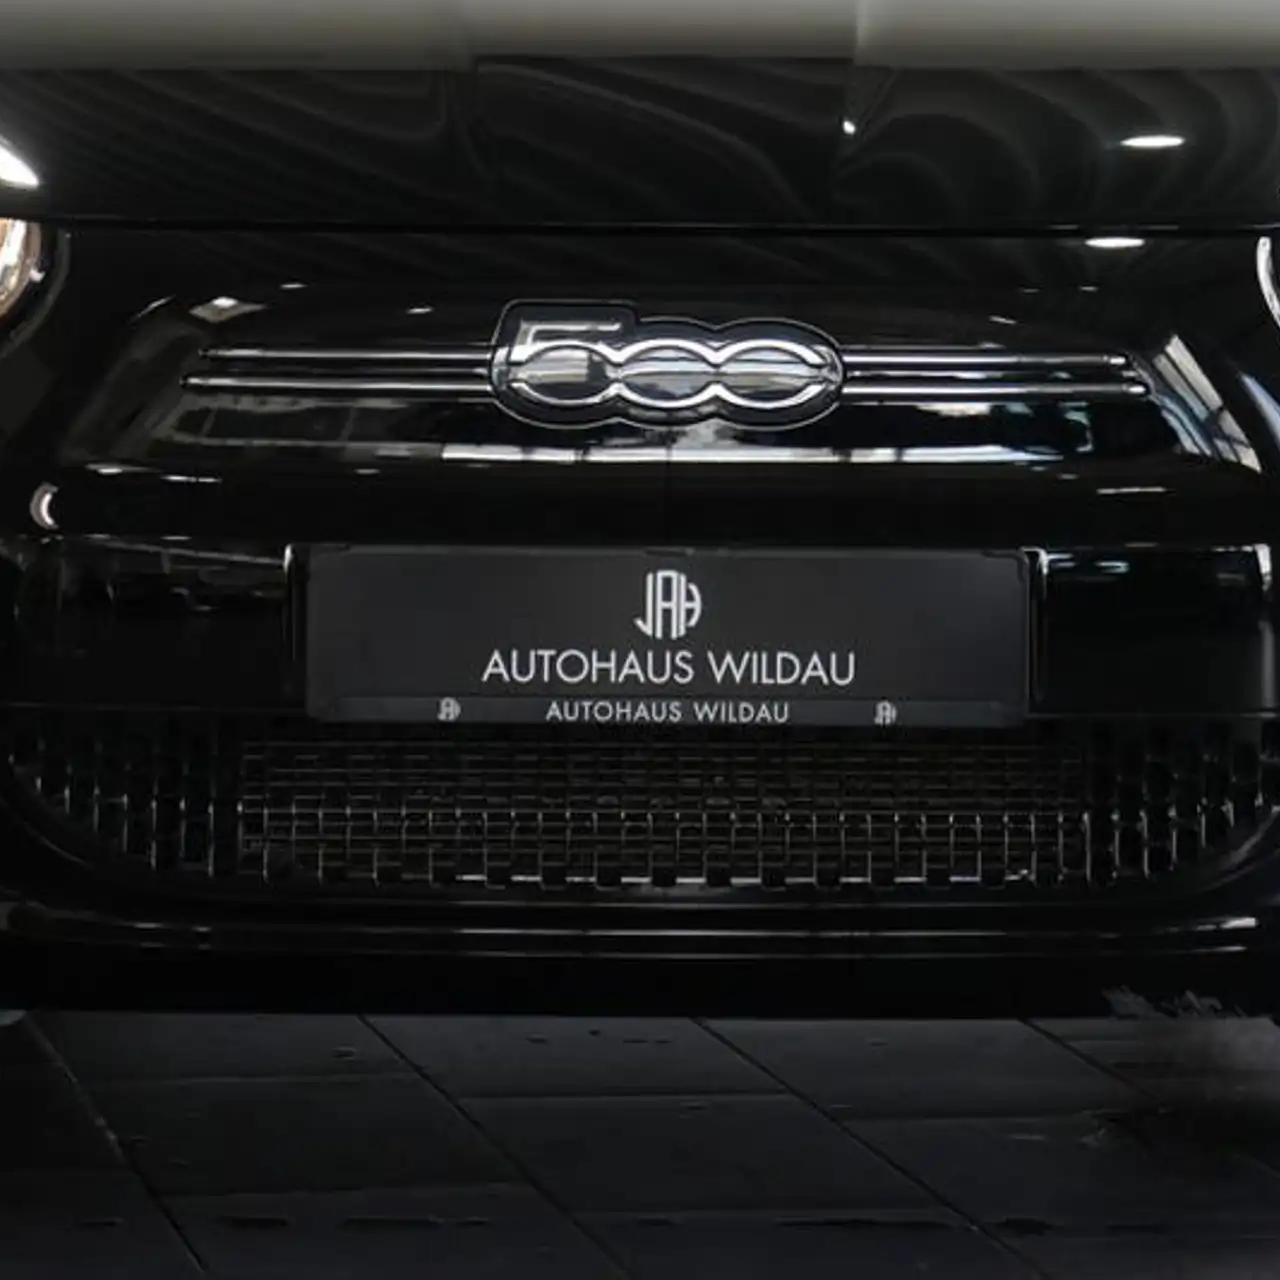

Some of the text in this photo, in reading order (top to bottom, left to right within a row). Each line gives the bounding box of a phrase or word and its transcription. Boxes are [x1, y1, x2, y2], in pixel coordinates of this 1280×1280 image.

[496, 314, 839, 416] 500
[480, 648, 857, 687] AUTOHAUS WILDAU
[545, 700, 790, 724] AUTOHAUS WILDAU
